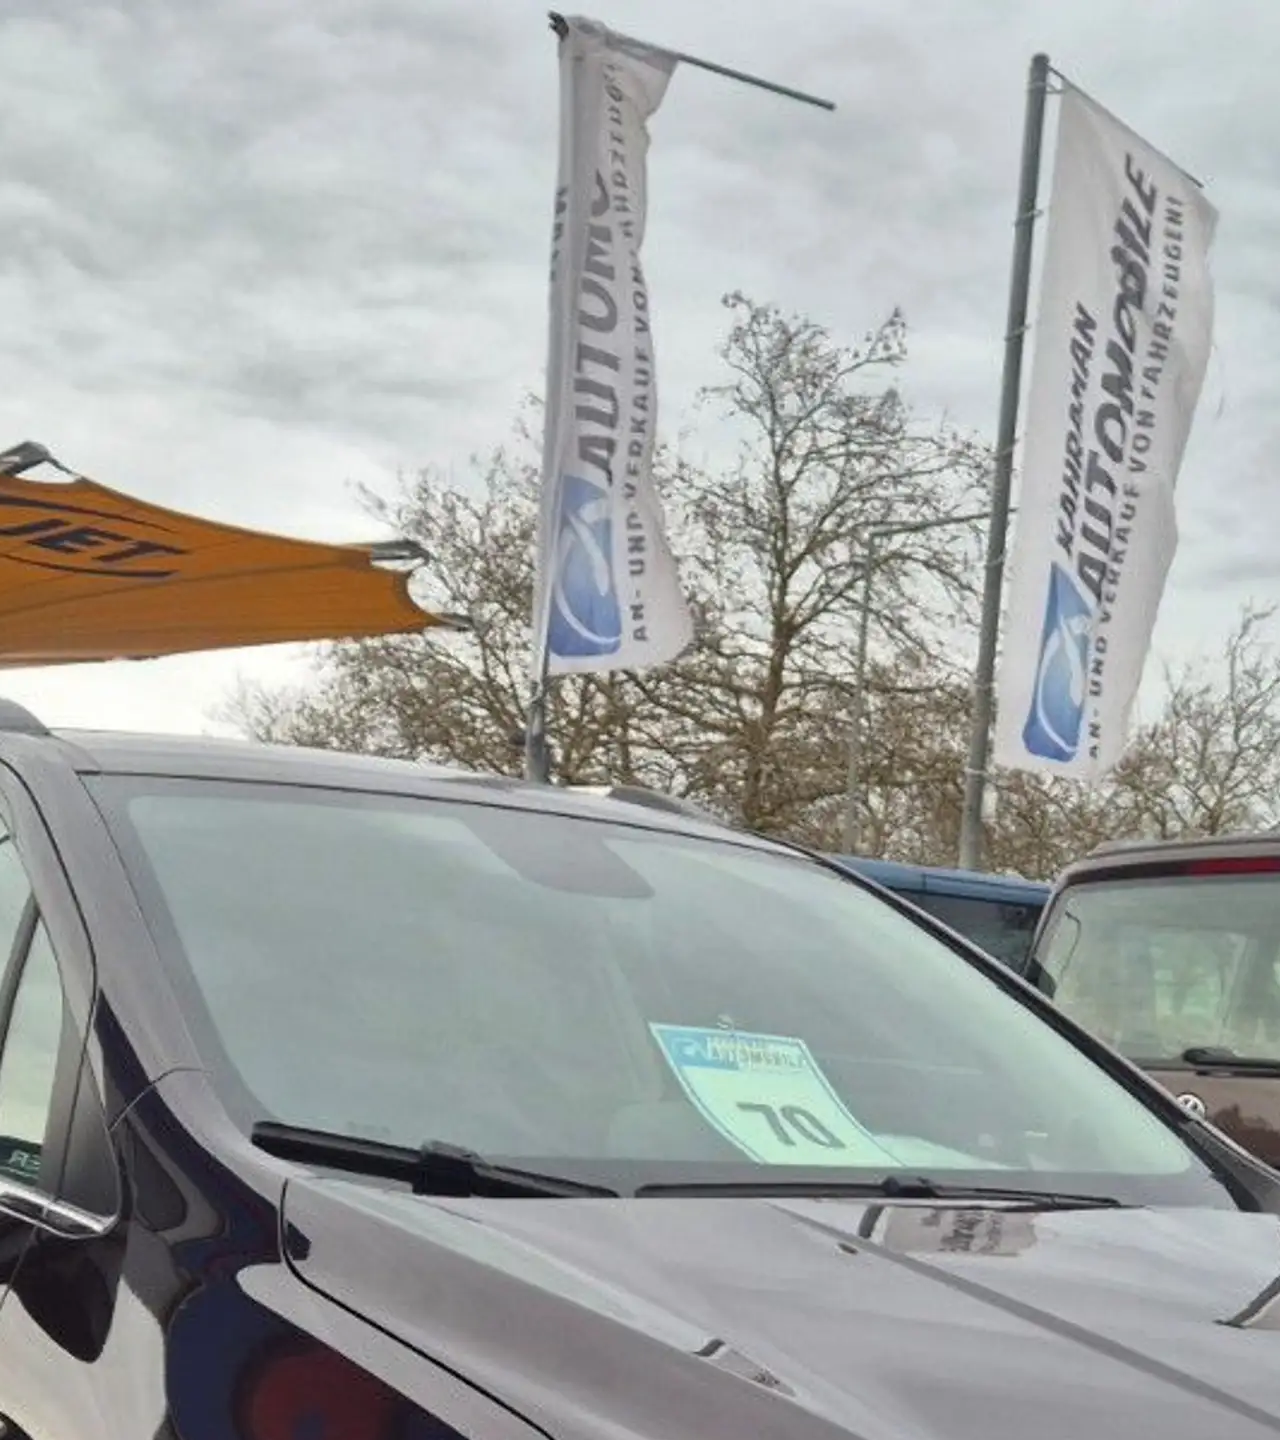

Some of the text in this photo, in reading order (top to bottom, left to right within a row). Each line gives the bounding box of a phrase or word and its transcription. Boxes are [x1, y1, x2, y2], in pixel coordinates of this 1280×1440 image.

[1128, 408, 1157, 473] VON
[1098, 482, 1141, 625] VERKAUF
[1089, 636, 1108, 698] UND
